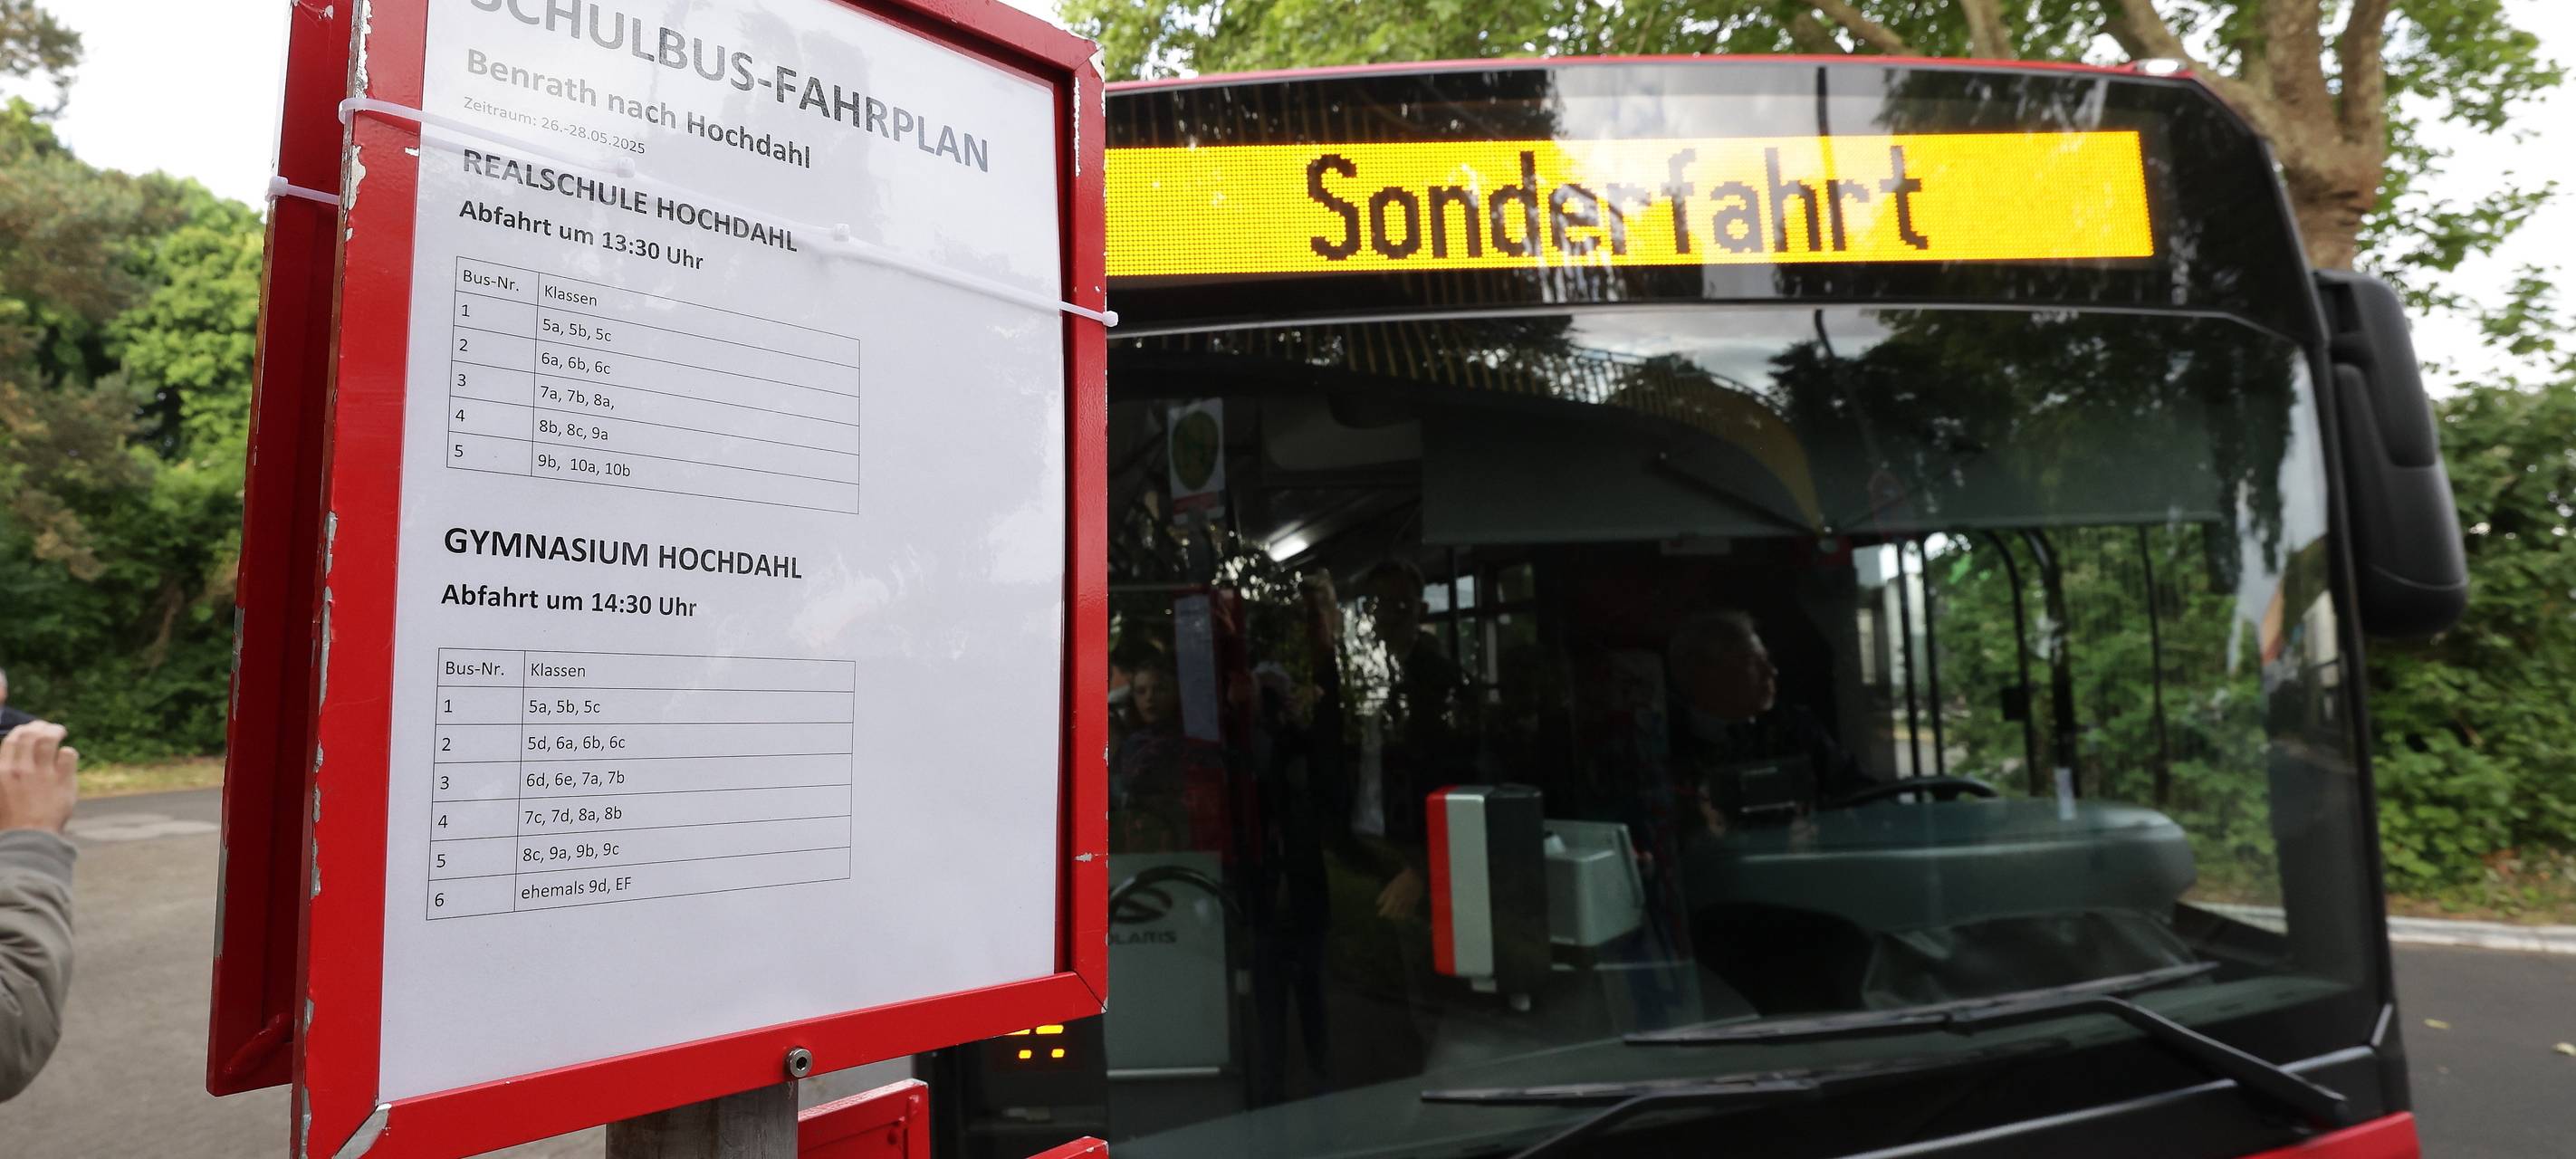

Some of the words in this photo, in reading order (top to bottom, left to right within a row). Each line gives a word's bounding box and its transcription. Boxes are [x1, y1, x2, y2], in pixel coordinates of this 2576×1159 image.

[468, 48, 598, 107] Benrath
[608, 93, 677, 129] nach
[687, 110, 811, 169] Hochdahl
[464, 96, 537, 127] Zeitraum:
[541, 117, 646, 154] 26.-28.05.2025
[464, 148, 648, 216] REALSCHULE
[656, 196, 798, 253] HOCHDAHL
[1307, 146, 1930, 261] Sonderfahrt
[458, 200, 552, 236] Abfahrt
[559, 225, 594, 245] um
[602, 231, 660, 260] 13:30
[666, 245, 704, 270] Uhr
[463, 270, 520, 292] Bus-Nr.
[544, 284, 598, 308] Klassen
[461, 303, 471, 318] 1
[542, 318, 564, 337] 5a,
[569, 322, 591, 341] 5b,
[595, 327, 612, 342] 5c
[459, 338, 468, 352] 2
[541, 351, 563, 369] 6a,
[568, 356, 590, 374] 6b,
[594, 360, 611, 375] 6c
[456, 373, 466, 388] 3
[540, 385, 562, 403] 7a,
[567, 388, 589, 407] 7b,
[593, 393, 615, 411] 8a,
[455, 408, 465, 423] 4
[539, 419, 562, 437] 8b,
[566, 423, 588, 441] 8c,
[591, 426, 608, 441] 9a
[454, 444, 464, 458] 5
[538, 454, 560, 472] 9b,
[570, 457, 600, 476] 10a,
[605, 462, 631, 477] 10b
[444, 527, 648, 568] GYMNASIUM
[658, 544, 802, 580] HOCHDAHL
[440, 583, 539, 609] Abfahrt
[546, 594, 583, 611] um
[591, 592, 652, 615] 14:30
[659, 596, 697, 618] Uhr
[445, 660, 504, 676] Bus-Nr.
[531, 662, 586, 677] Klassen
[444, 699, 453, 714] 1
[528, 699, 551, 716] 5a,
[556, 699, 579, 716] 5b,
[583, 700, 601, 714] 5c
[441, 737, 451, 752] 2
[527, 735, 551, 752] 5d,
[556, 735, 578, 752] 6a,
[582, 734, 605, 752] 6b,
[609, 735, 626, 749] 6c
[439, 775, 450, 790] 3
[526, 773, 550, 790] 6d,
[554, 772, 577, 789] 6e,
[581, 771, 603, 788] 7a,
[608, 770, 625, 785] 7b
[437, 814, 448, 829] 4
[524, 810, 546, 827] 7c,
[551, 808, 574, 825] 7d,
[578, 808, 600, 824] 8a,
[604, 805, 623, 820] 8b
[436, 853, 446, 868] 5
[522, 848, 544, 864] 8c,
[549, 846, 571, 862] 9a,
[576, 843, 599, 860] 9b,
[603, 842, 619, 857] 9c
[521, 881, 585, 900] ehemals
[589, 879, 611, 895] 9d,
[616, 876, 632, 891] EF
[435, 892, 445, 907] 6
